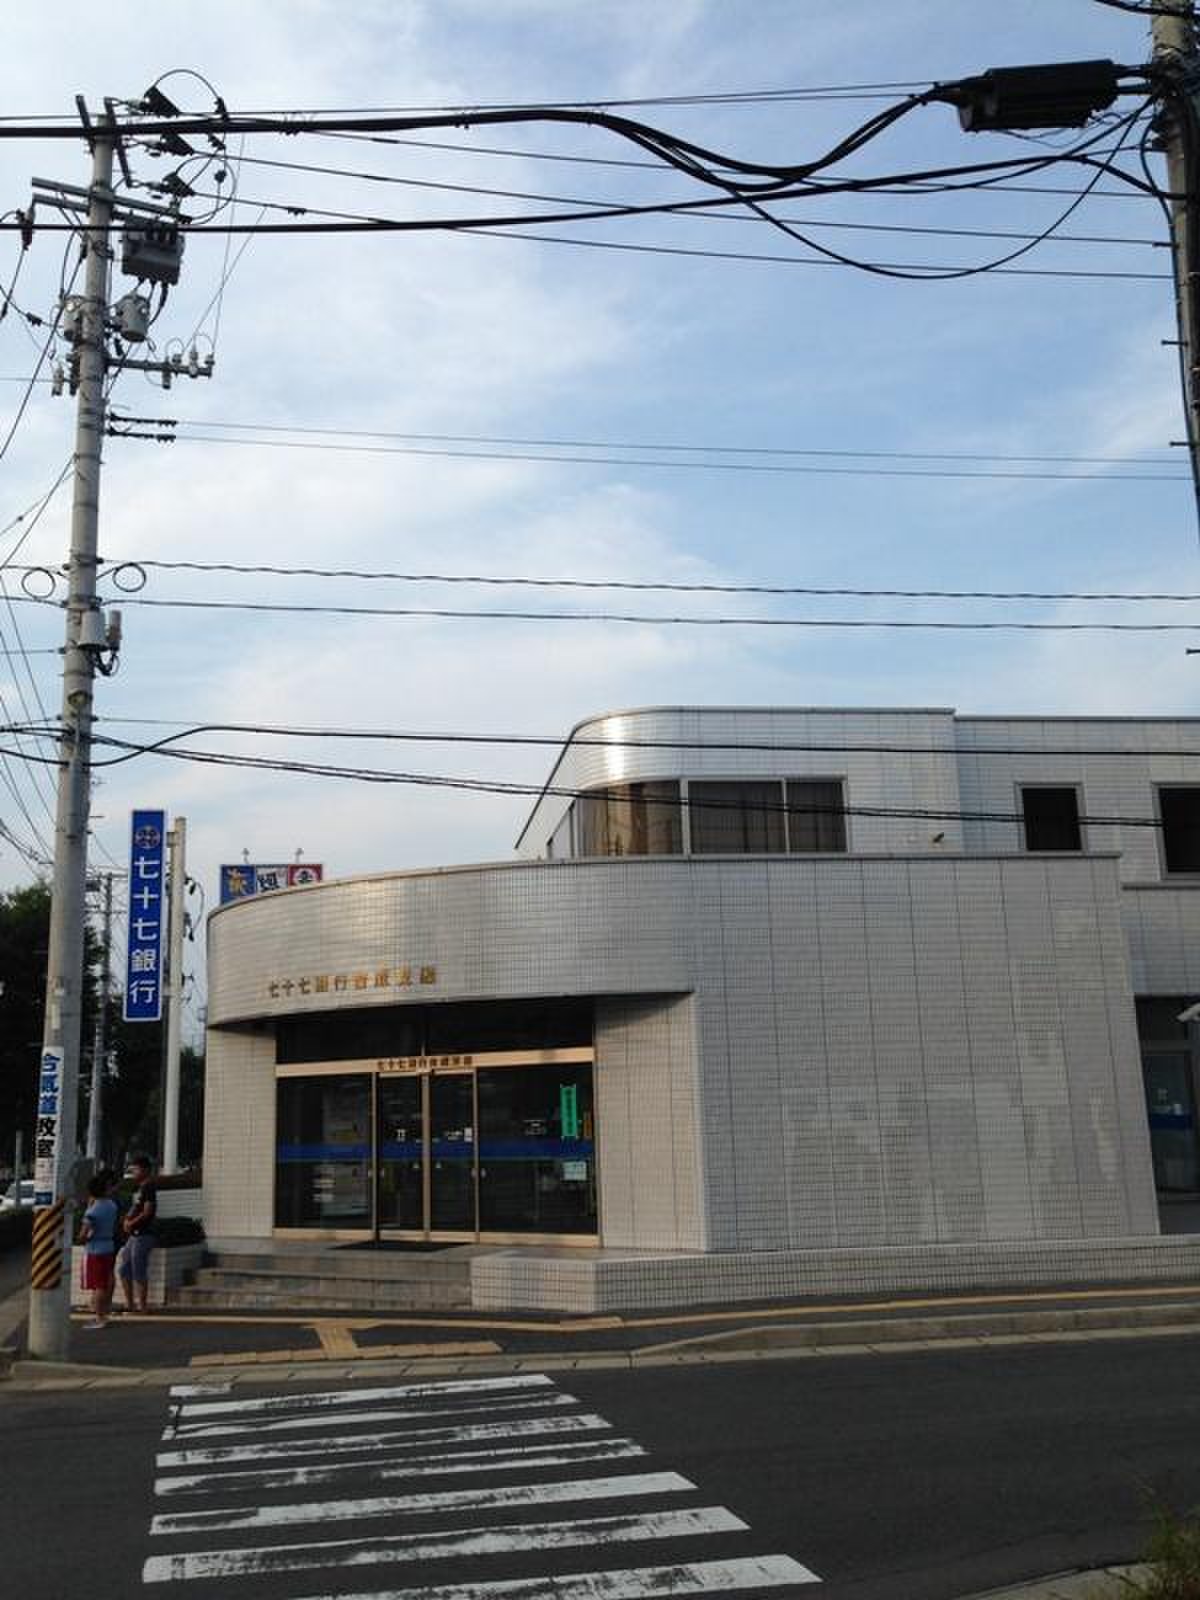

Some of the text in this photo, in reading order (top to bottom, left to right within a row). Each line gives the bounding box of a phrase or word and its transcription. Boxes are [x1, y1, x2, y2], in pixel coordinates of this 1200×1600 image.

[129, 856, 160, 1004] 七十七銀行
